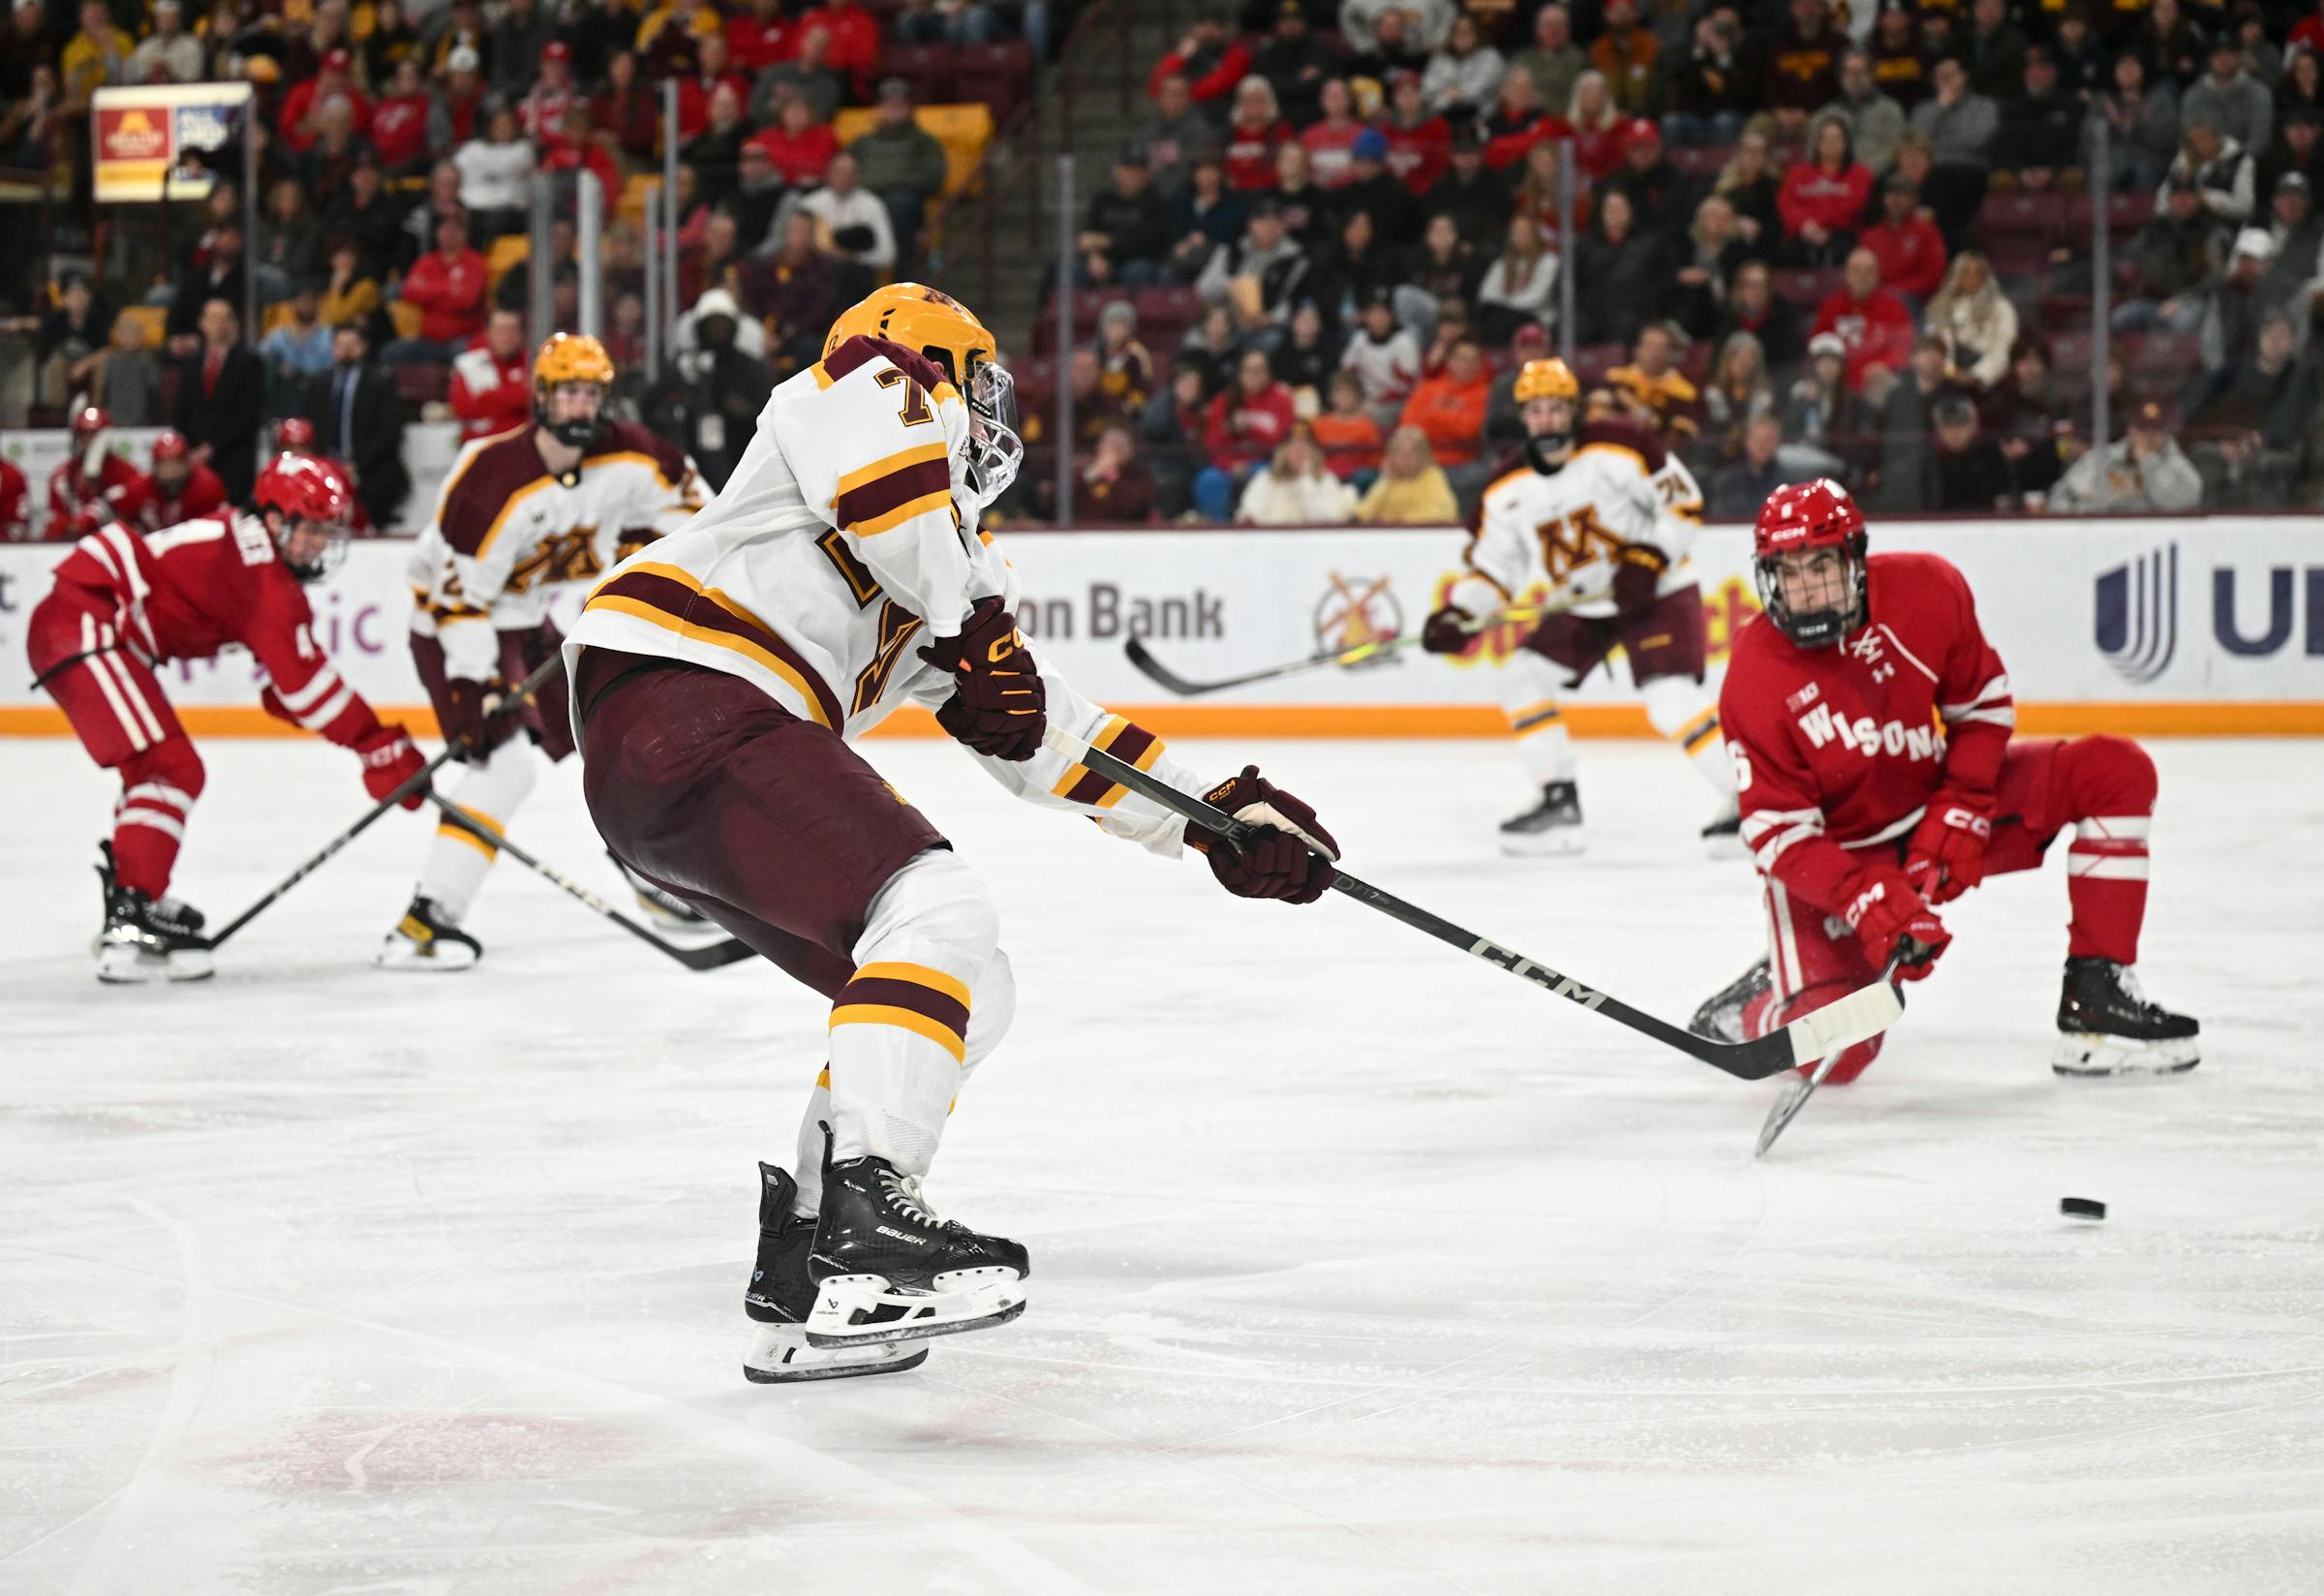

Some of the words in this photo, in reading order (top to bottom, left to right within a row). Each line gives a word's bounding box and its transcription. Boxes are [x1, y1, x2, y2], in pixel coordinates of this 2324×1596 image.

[873, 367, 933, 427] 7
[1771, 526, 1807, 542] CCM
[1089, 583, 1224, 639] Bank
[1208, 779, 1237, 802] CCM
[1469, 936, 1609, 1011] CCM
